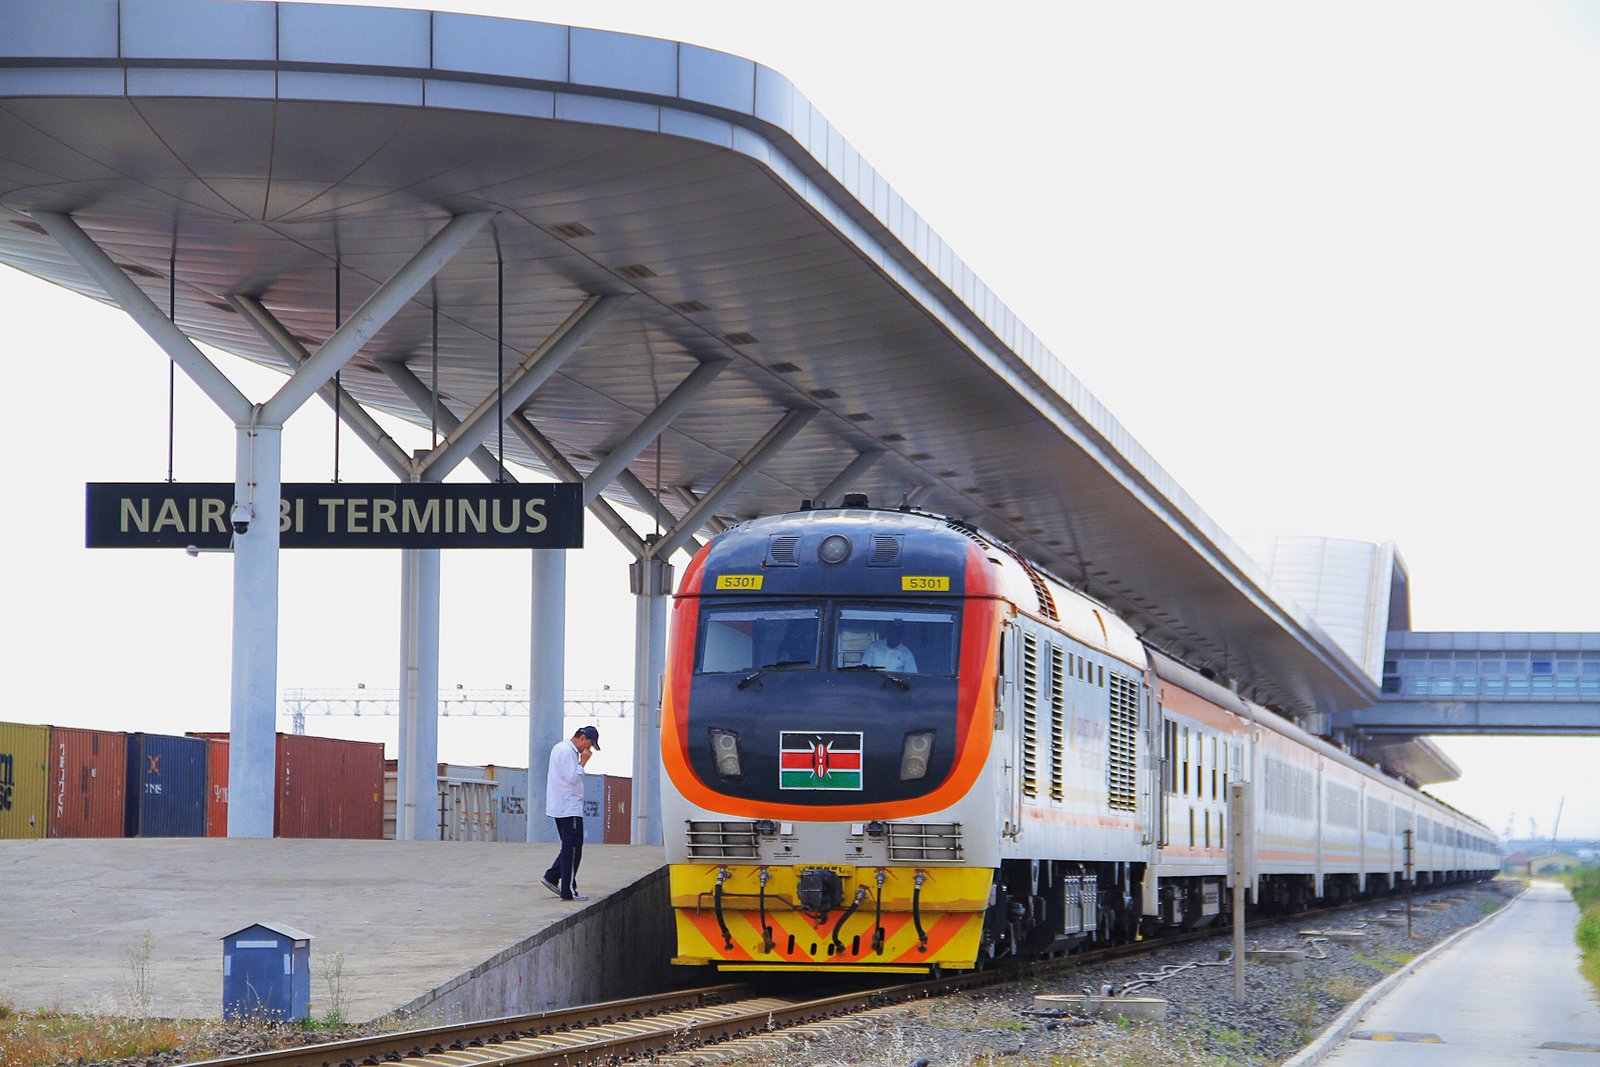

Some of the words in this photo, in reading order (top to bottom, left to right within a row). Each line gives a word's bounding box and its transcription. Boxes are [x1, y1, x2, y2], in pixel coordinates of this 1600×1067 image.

[120, 498, 304, 533] NAIRBI
[318, 498, 548, 533] TERMINUS
[725, 578, 755, 587] 5301
[910, 579, 941, 589] 5301
